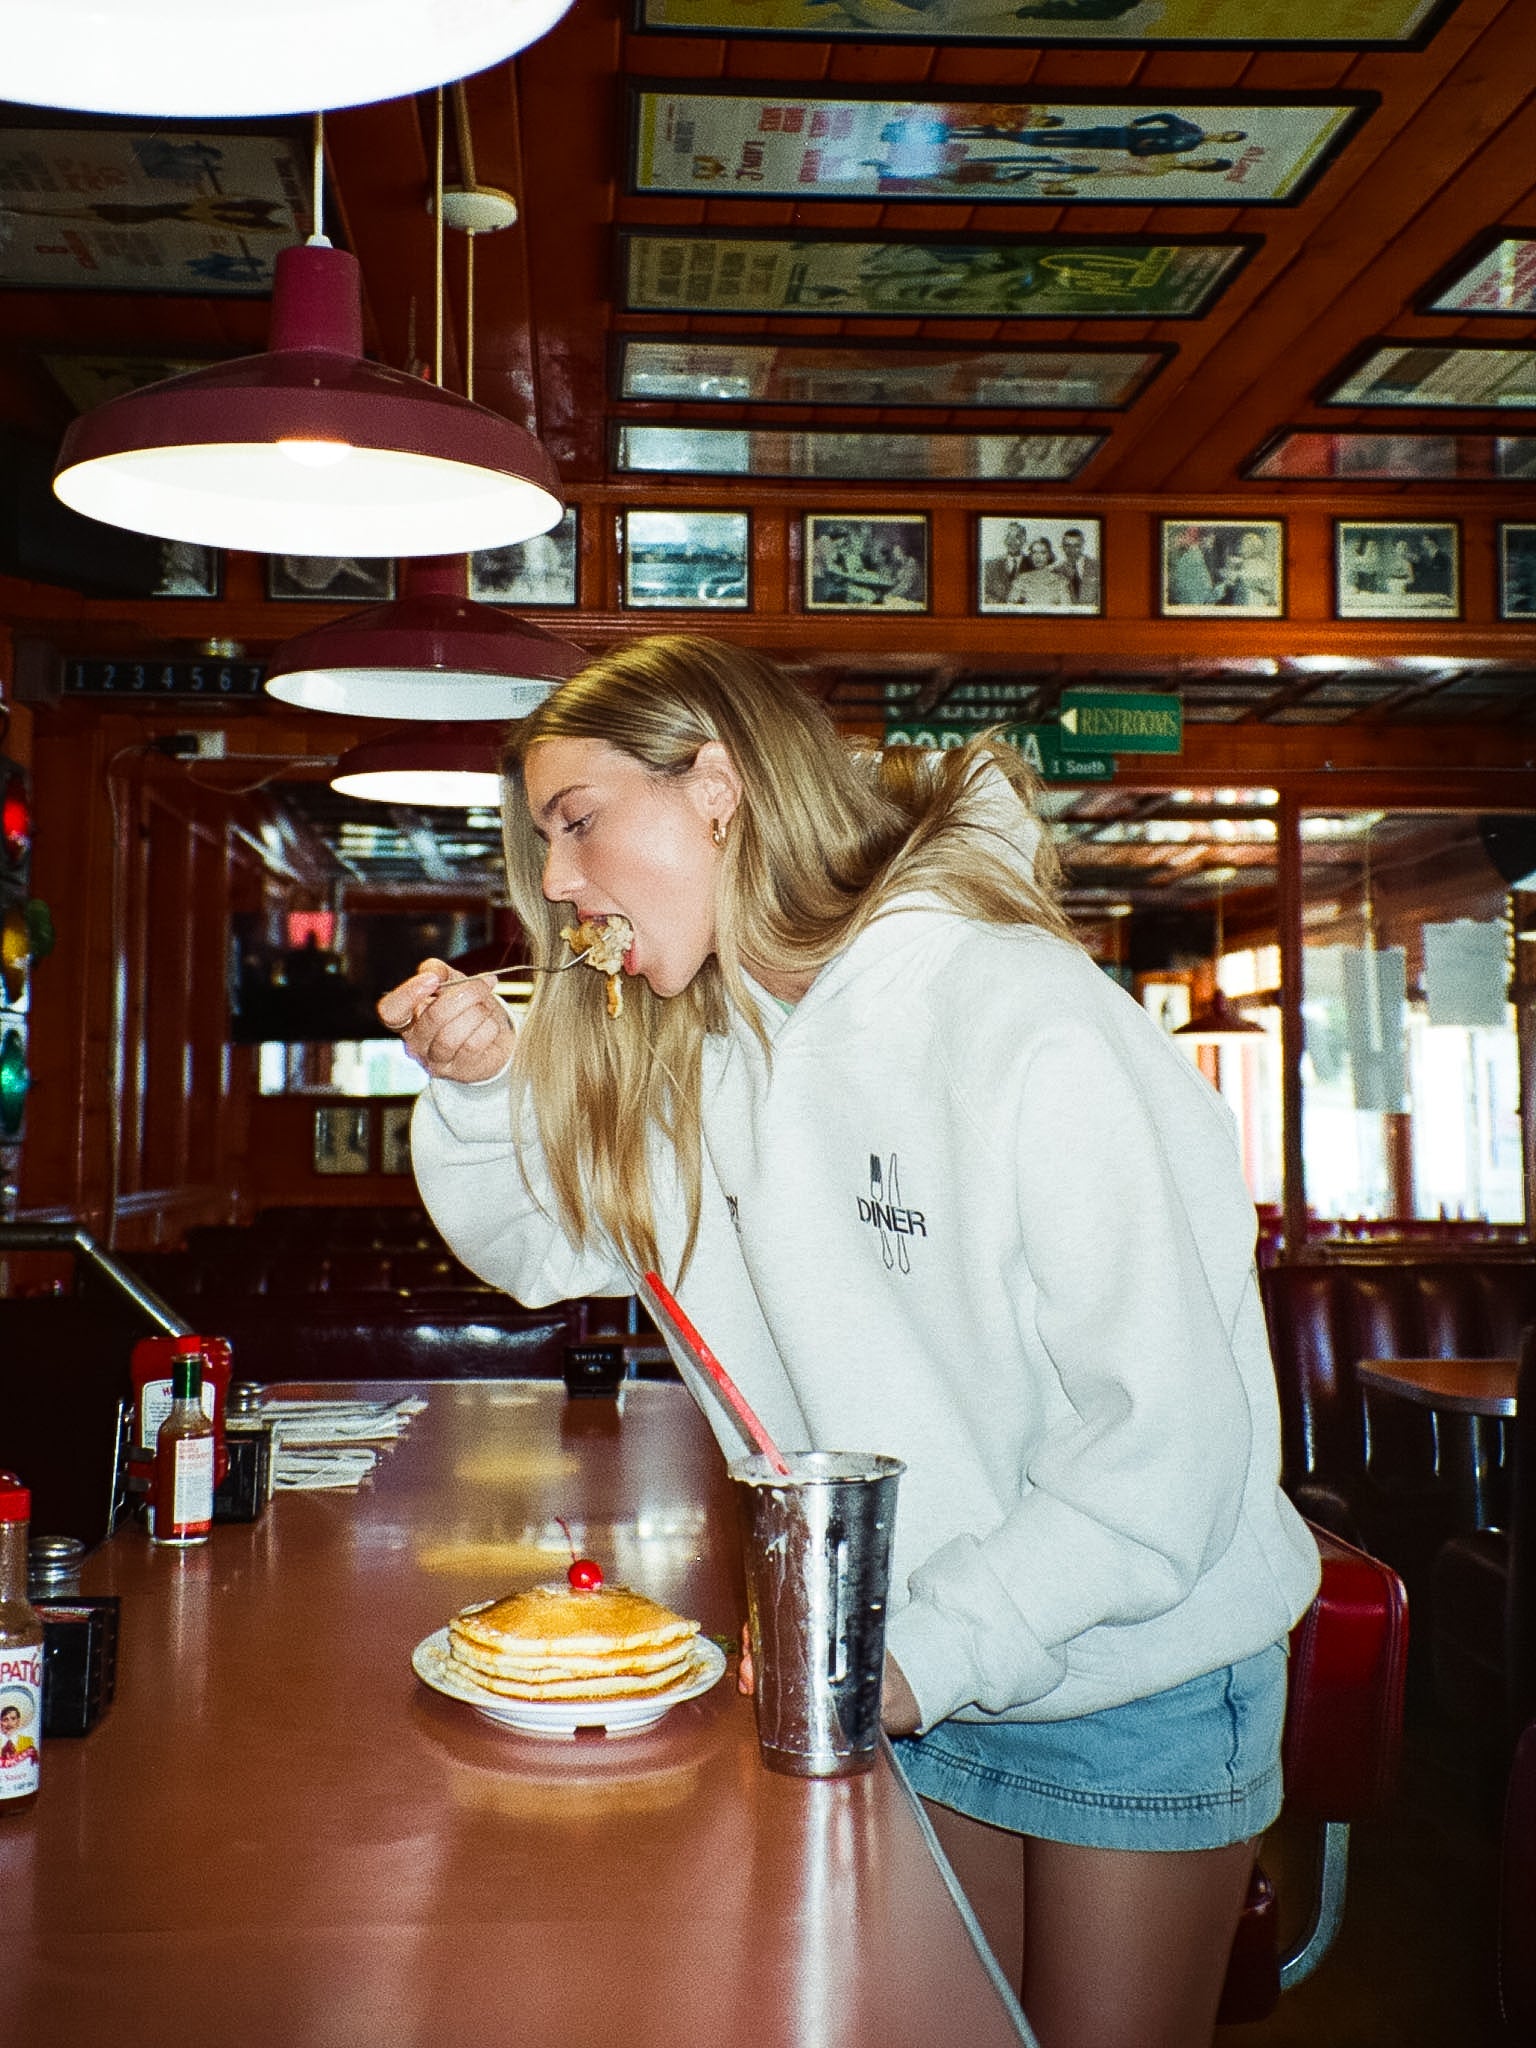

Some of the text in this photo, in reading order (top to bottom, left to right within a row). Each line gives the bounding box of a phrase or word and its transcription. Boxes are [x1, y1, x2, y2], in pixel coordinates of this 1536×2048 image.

[75, 664, 262, 692] 1 2 3 4 5 6 7
[1082, 708, 1178, 736] RESTROOMS
[1066, 760, 1106, 775] South
[856, 1196, 927, 1238] DINER
